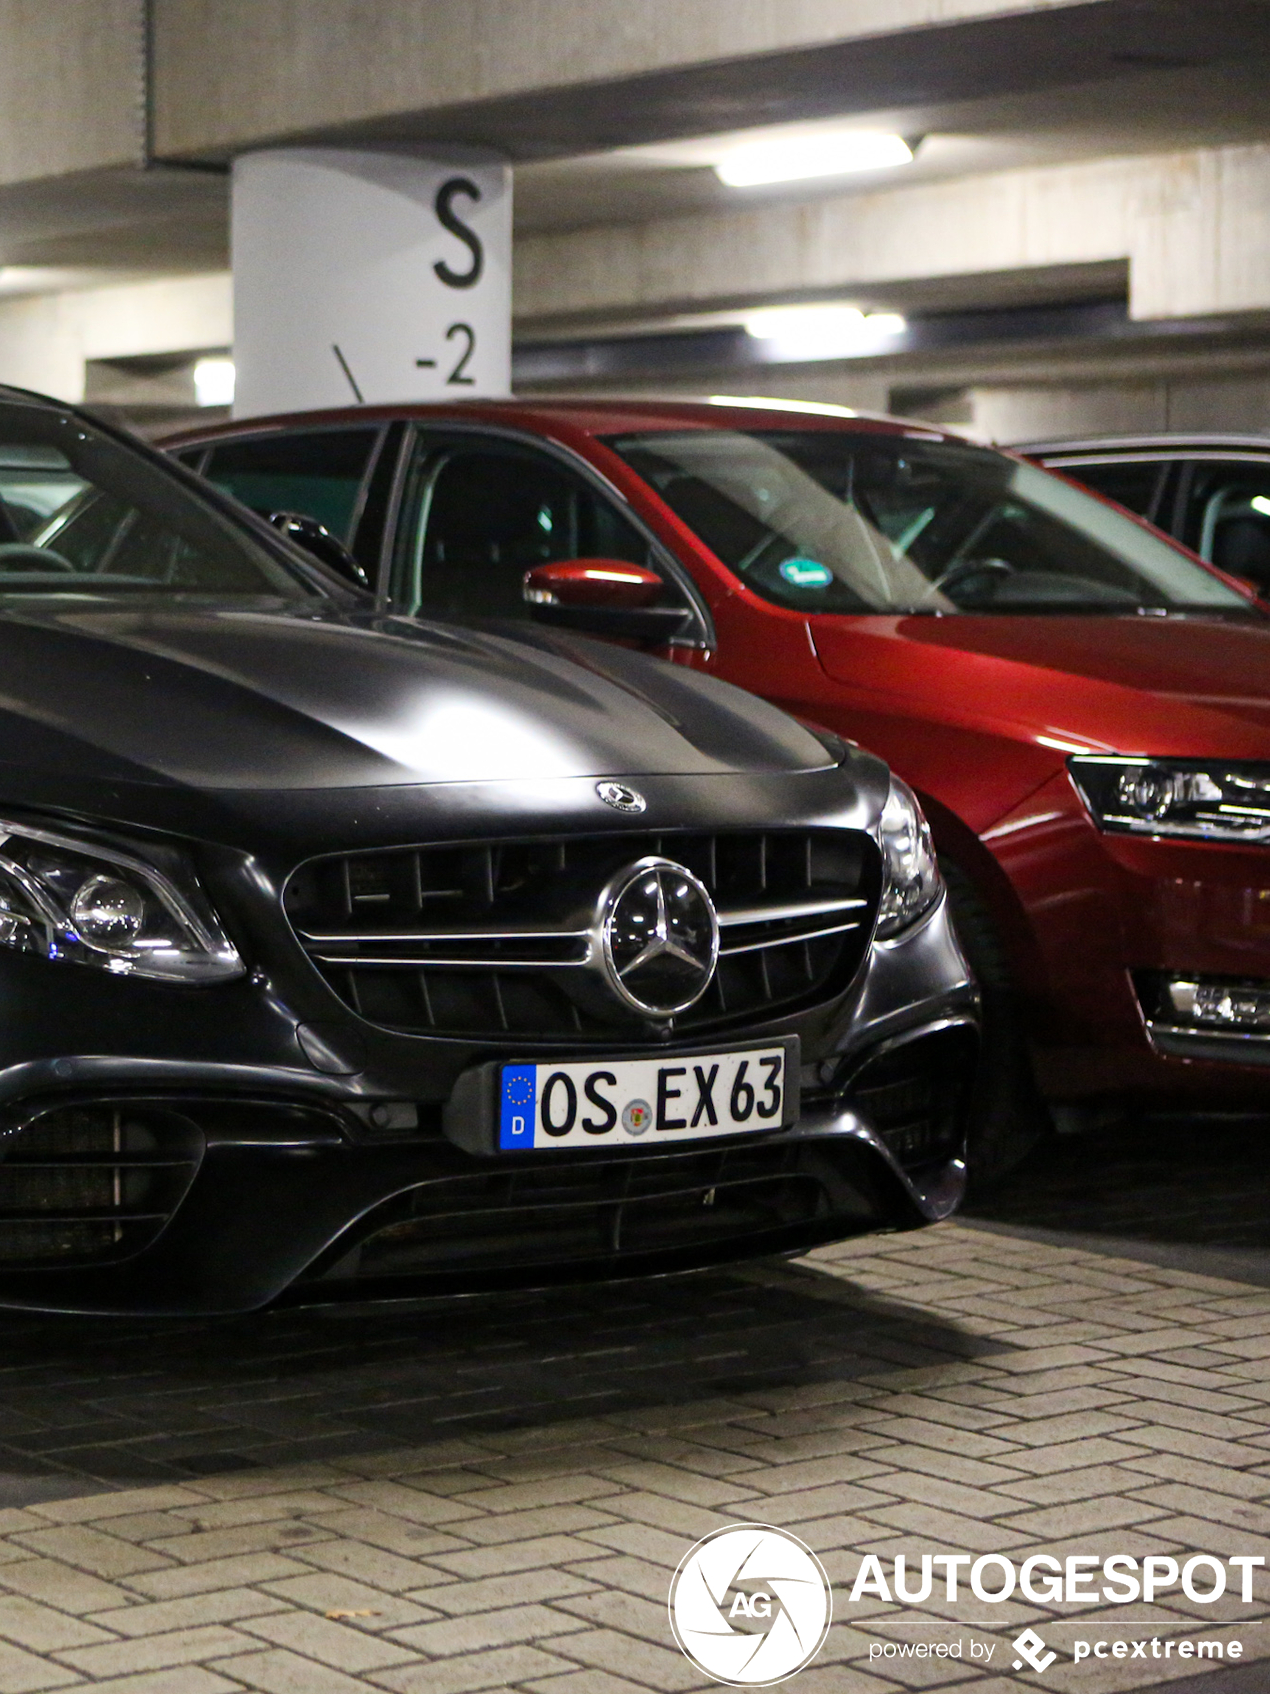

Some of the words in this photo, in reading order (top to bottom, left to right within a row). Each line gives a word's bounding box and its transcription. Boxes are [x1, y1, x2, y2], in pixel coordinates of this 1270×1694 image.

[432, 178, 483, 289] S
[415, 323, 476, 385] -2
[540, 1071, 618, 1137] OS
[656, 1064, 720, 1131] EX
[730, 1056, 782, 1122] 63
